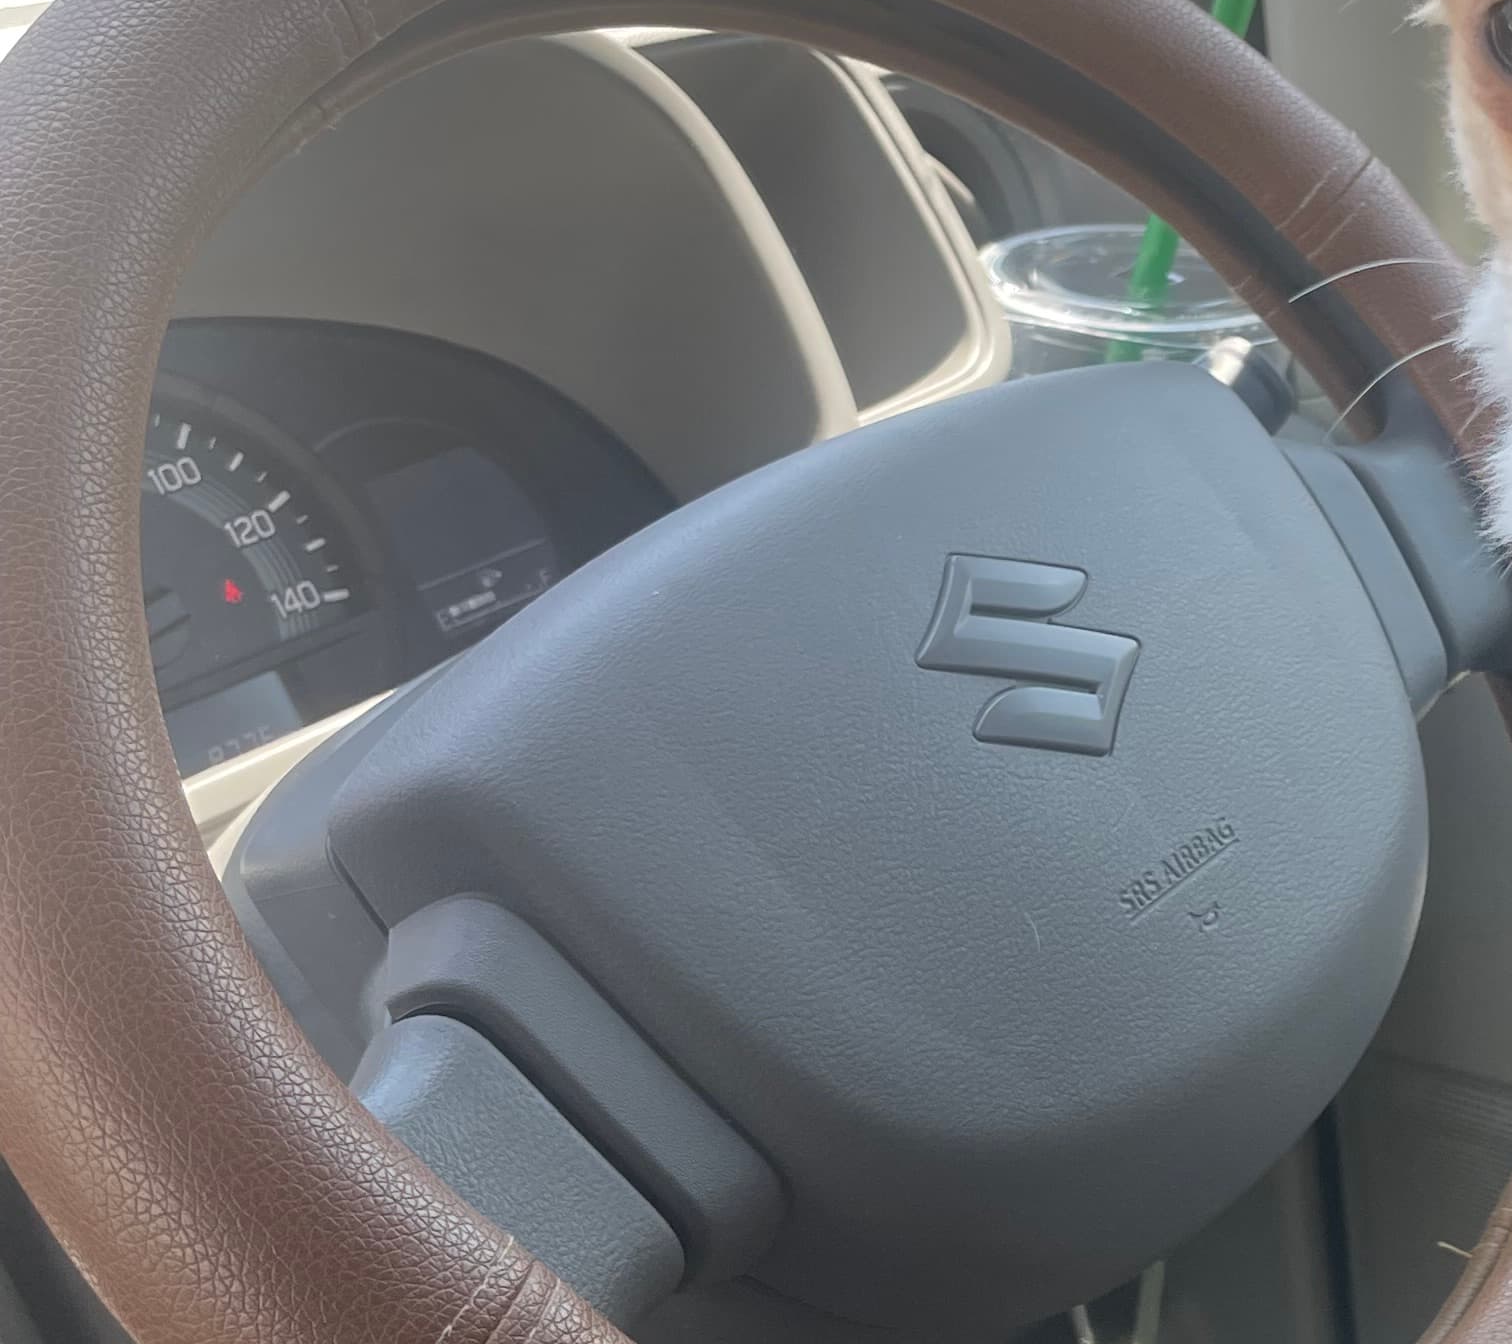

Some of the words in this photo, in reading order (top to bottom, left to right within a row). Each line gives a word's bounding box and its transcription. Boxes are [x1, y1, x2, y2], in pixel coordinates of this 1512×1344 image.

[147, 455, 203, 495] 100
[224, 508, 276, 549] 120
[270, 578, 321, 619] 140
[1119, 869, 1163, 917] SRS
[1159, 816, 1237, 887] AIRBAG
